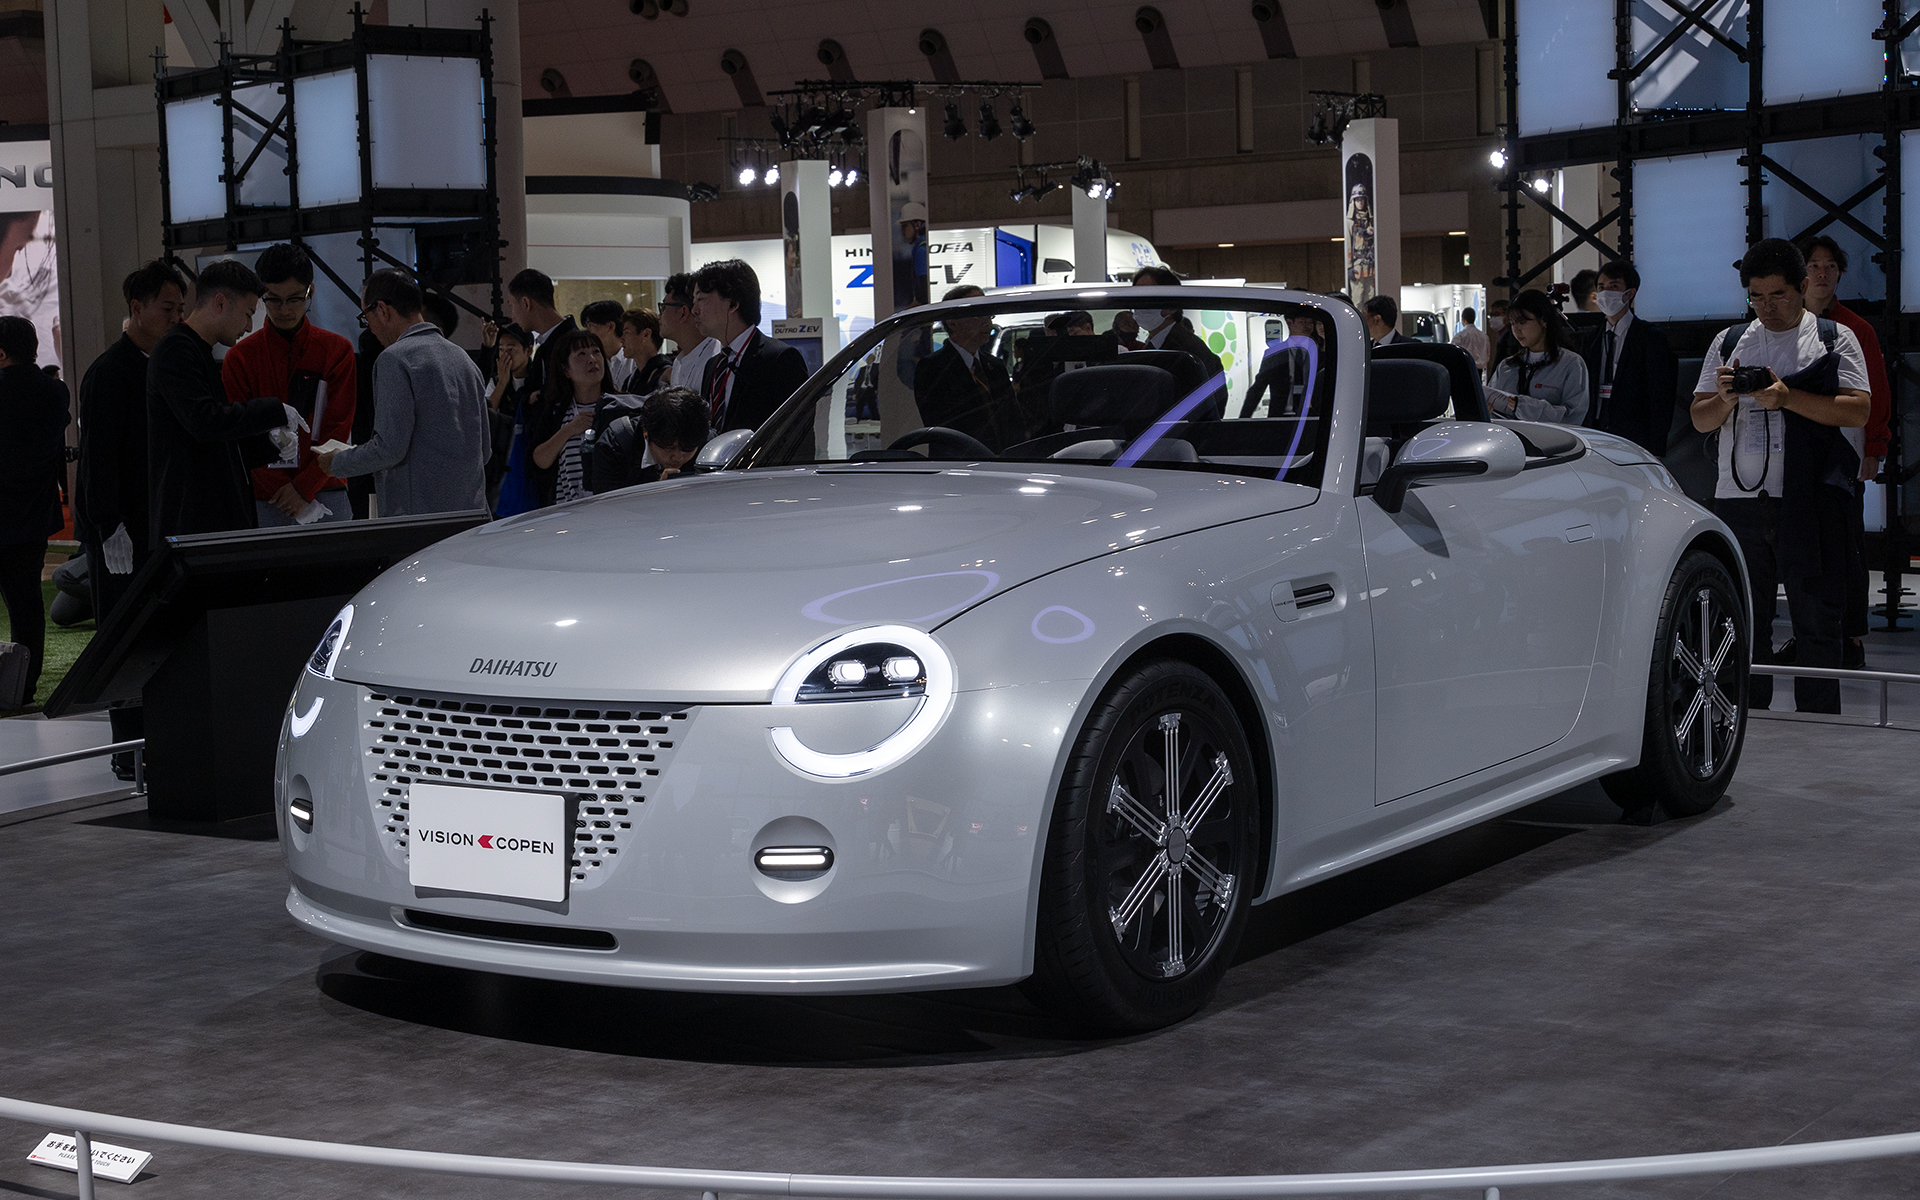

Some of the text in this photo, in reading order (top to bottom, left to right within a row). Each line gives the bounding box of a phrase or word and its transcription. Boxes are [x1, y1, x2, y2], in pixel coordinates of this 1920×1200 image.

[845, 242, 974, 257] HIN OFIA
[469, 657, 558, 678] DAIHATSU
[418, 829, 554, 855] VISION COPEN
